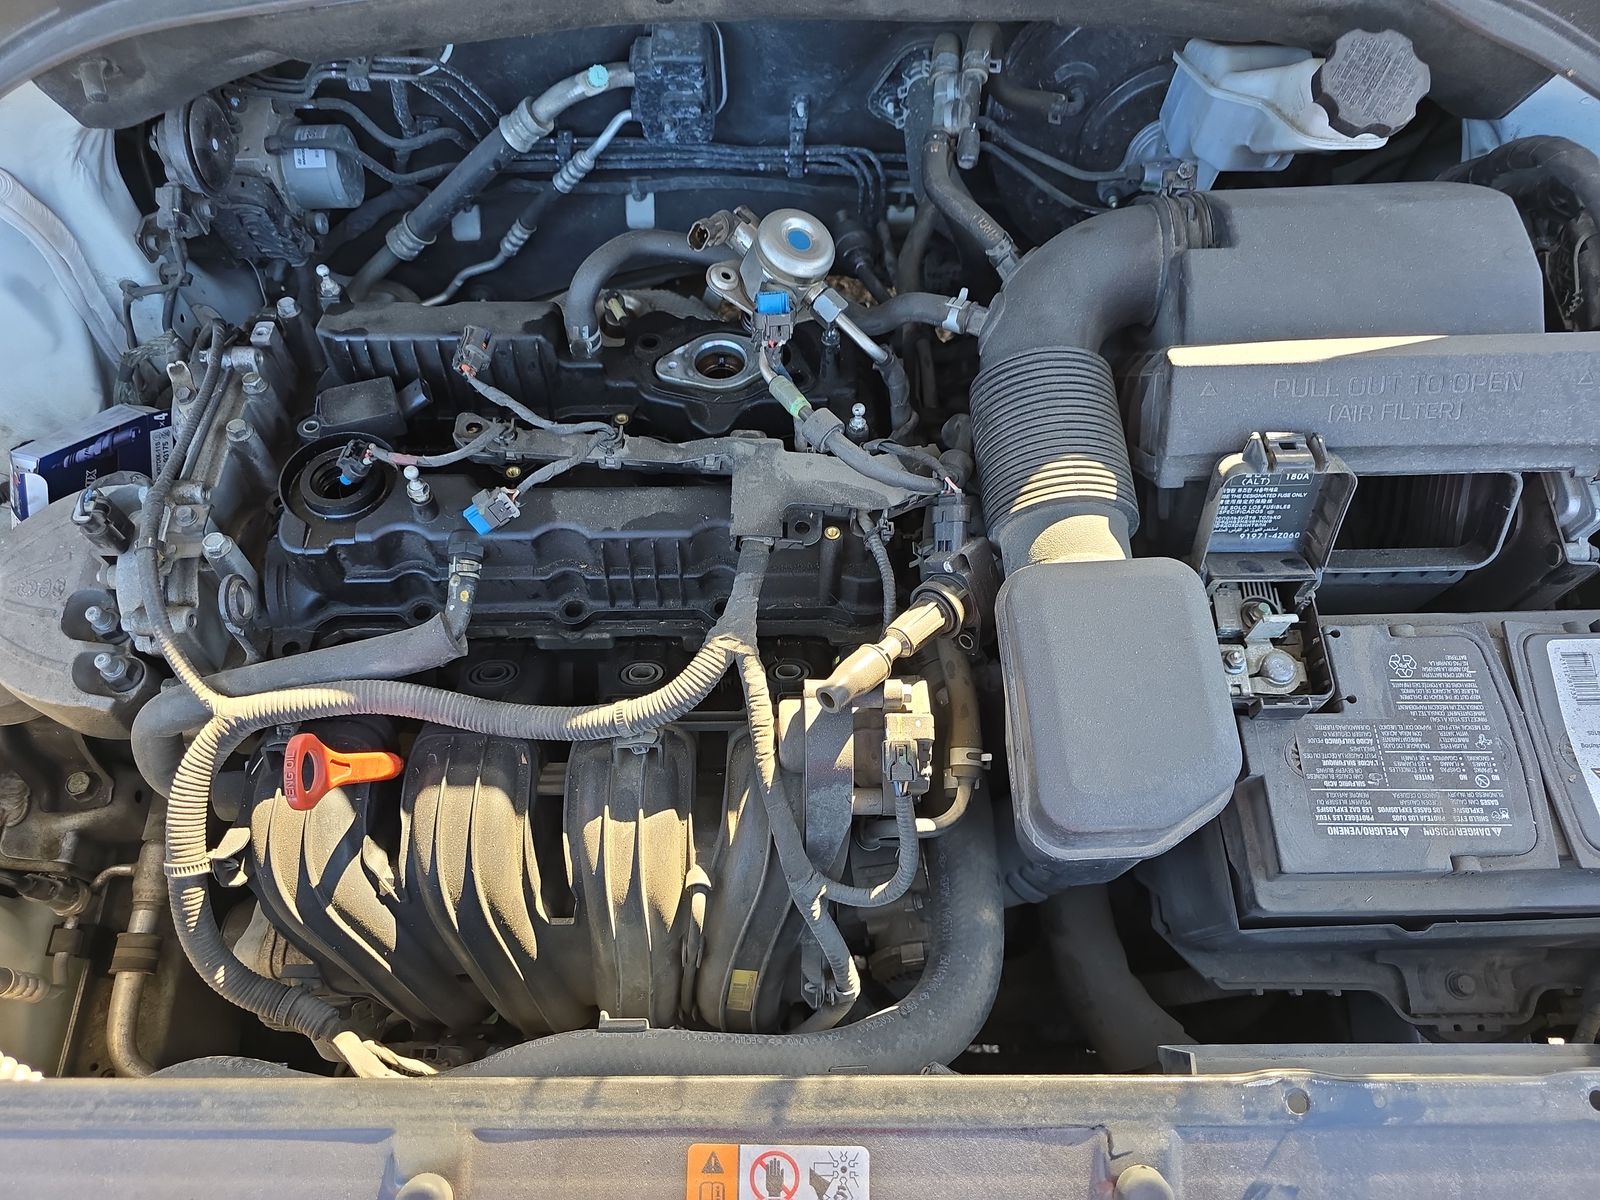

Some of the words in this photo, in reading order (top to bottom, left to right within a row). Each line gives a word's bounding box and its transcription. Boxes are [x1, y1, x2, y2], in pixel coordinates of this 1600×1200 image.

[1273, 377, 1340, 398] PULL
[1348, 374, 1400, 396] OUT
[1410, 372, 1446, 395] TO
[1450, 369, 1525, 394] OPEN
[1241, 478, 1271, 486] (ALT)
[1286, 473, 1310, 481] 180A
[1239, 532, 1301, 540] 91971-4Z060
[286, 751, 296, 769] OIL
[286, 772, 296, 796] ENG
[1327, 826, 1399, 836] PELIGRO/VENENO
